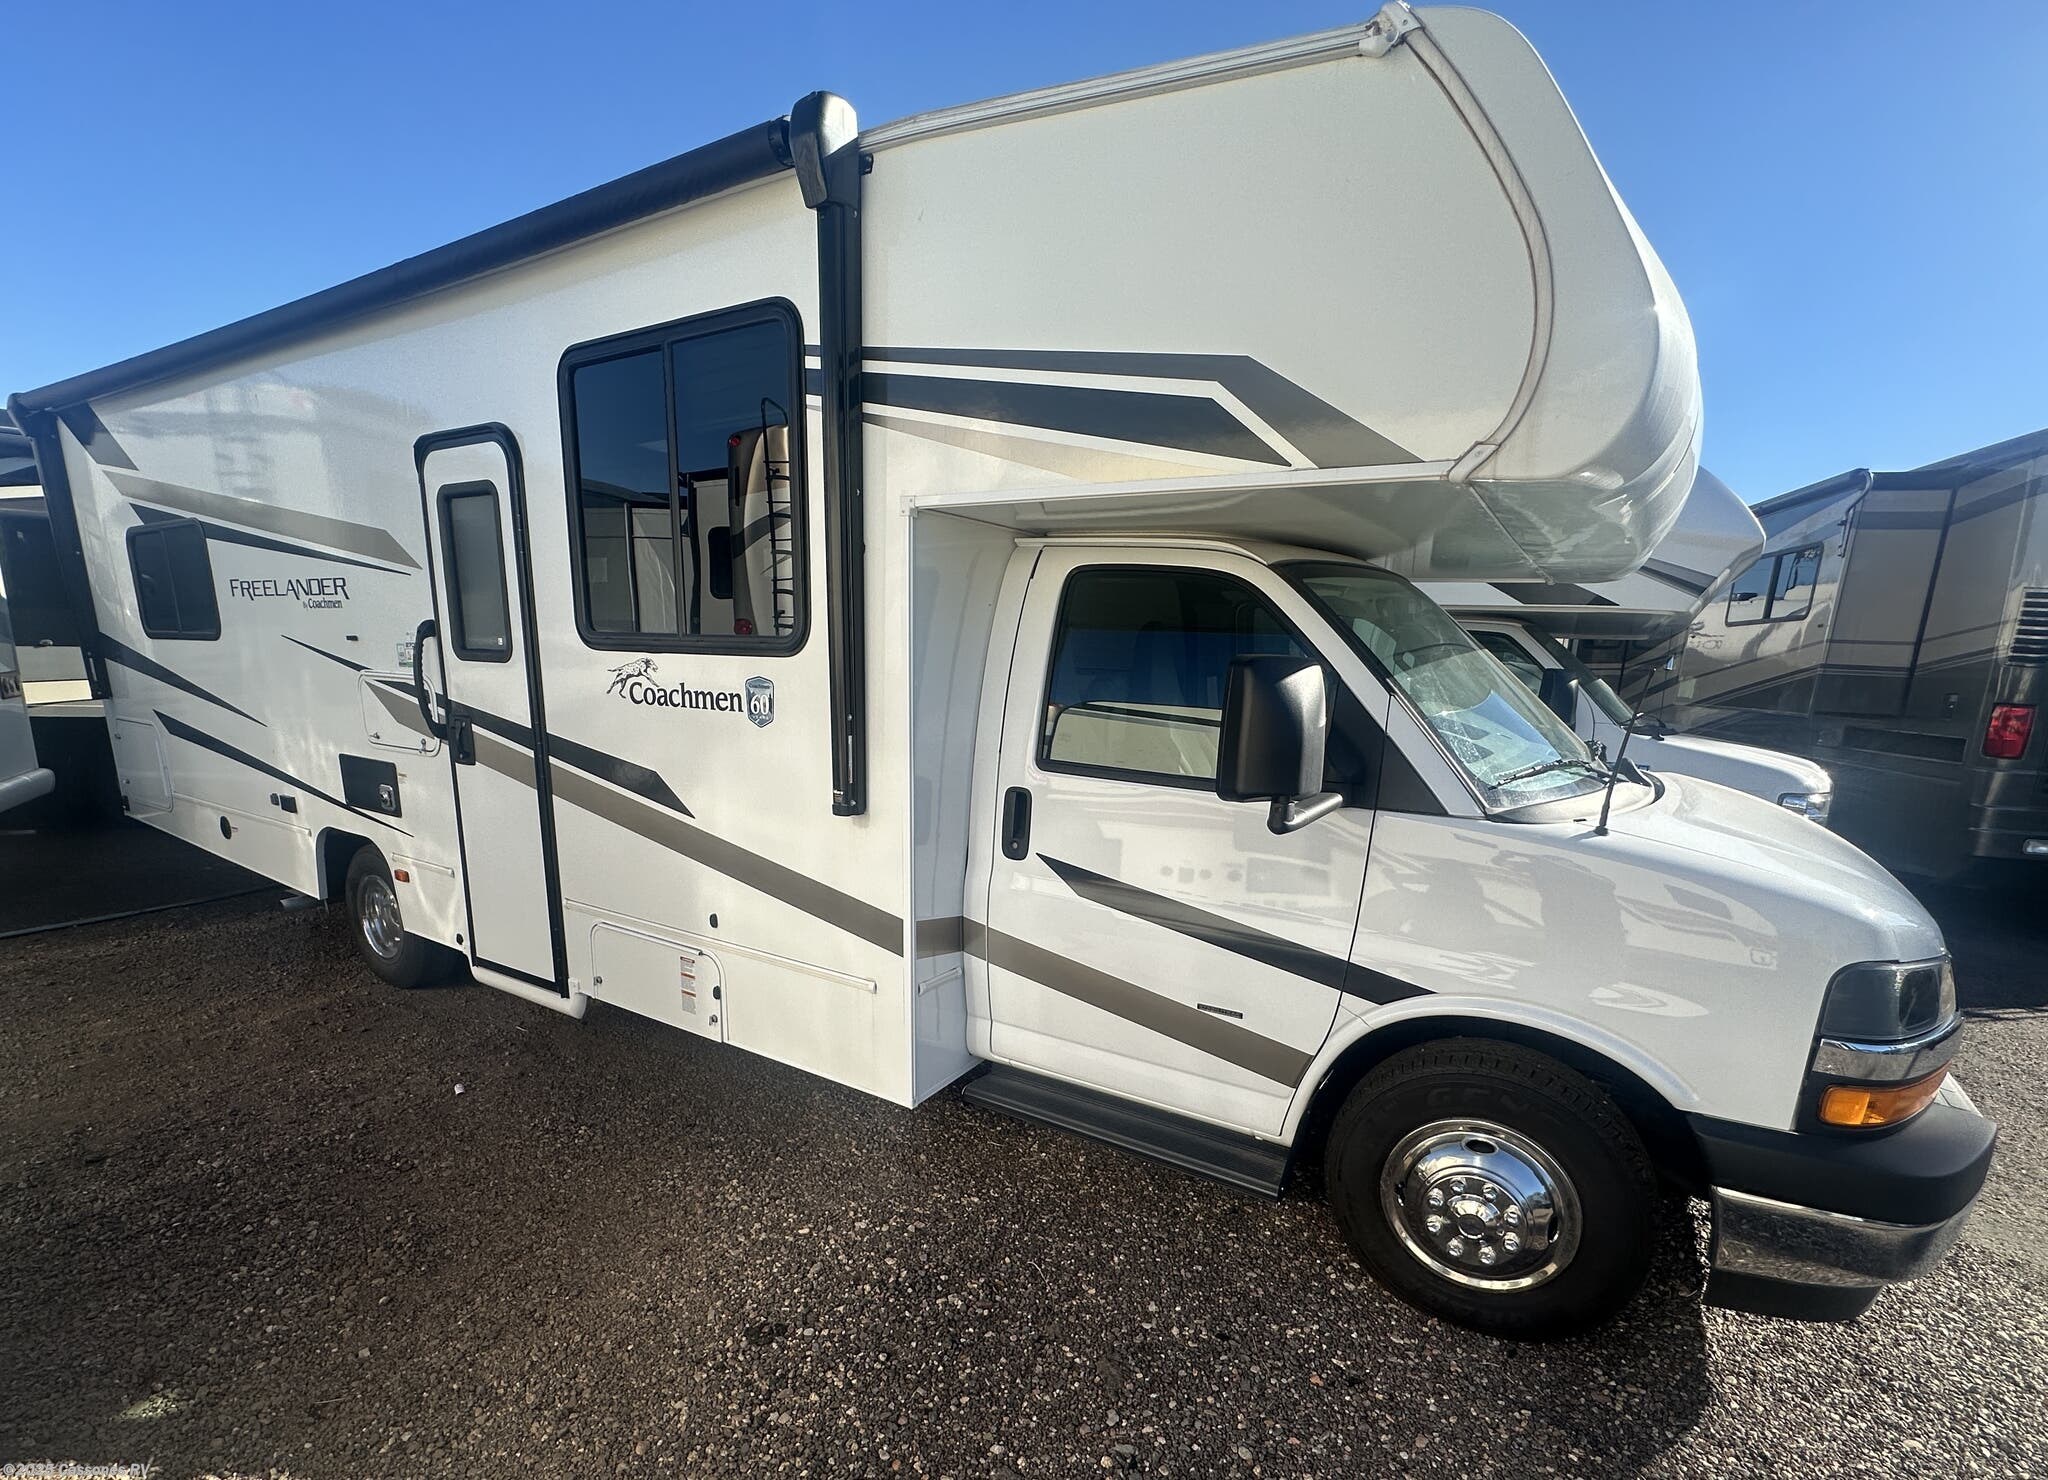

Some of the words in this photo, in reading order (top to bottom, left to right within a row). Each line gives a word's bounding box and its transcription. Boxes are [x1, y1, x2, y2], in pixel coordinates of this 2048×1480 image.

[229, 577, 350, 601] FREELANDER
[308, 598, 343, 609] Coachmen
[629, 682, 744, 713] Coachmen
[750, 694, 769, 715] 60
